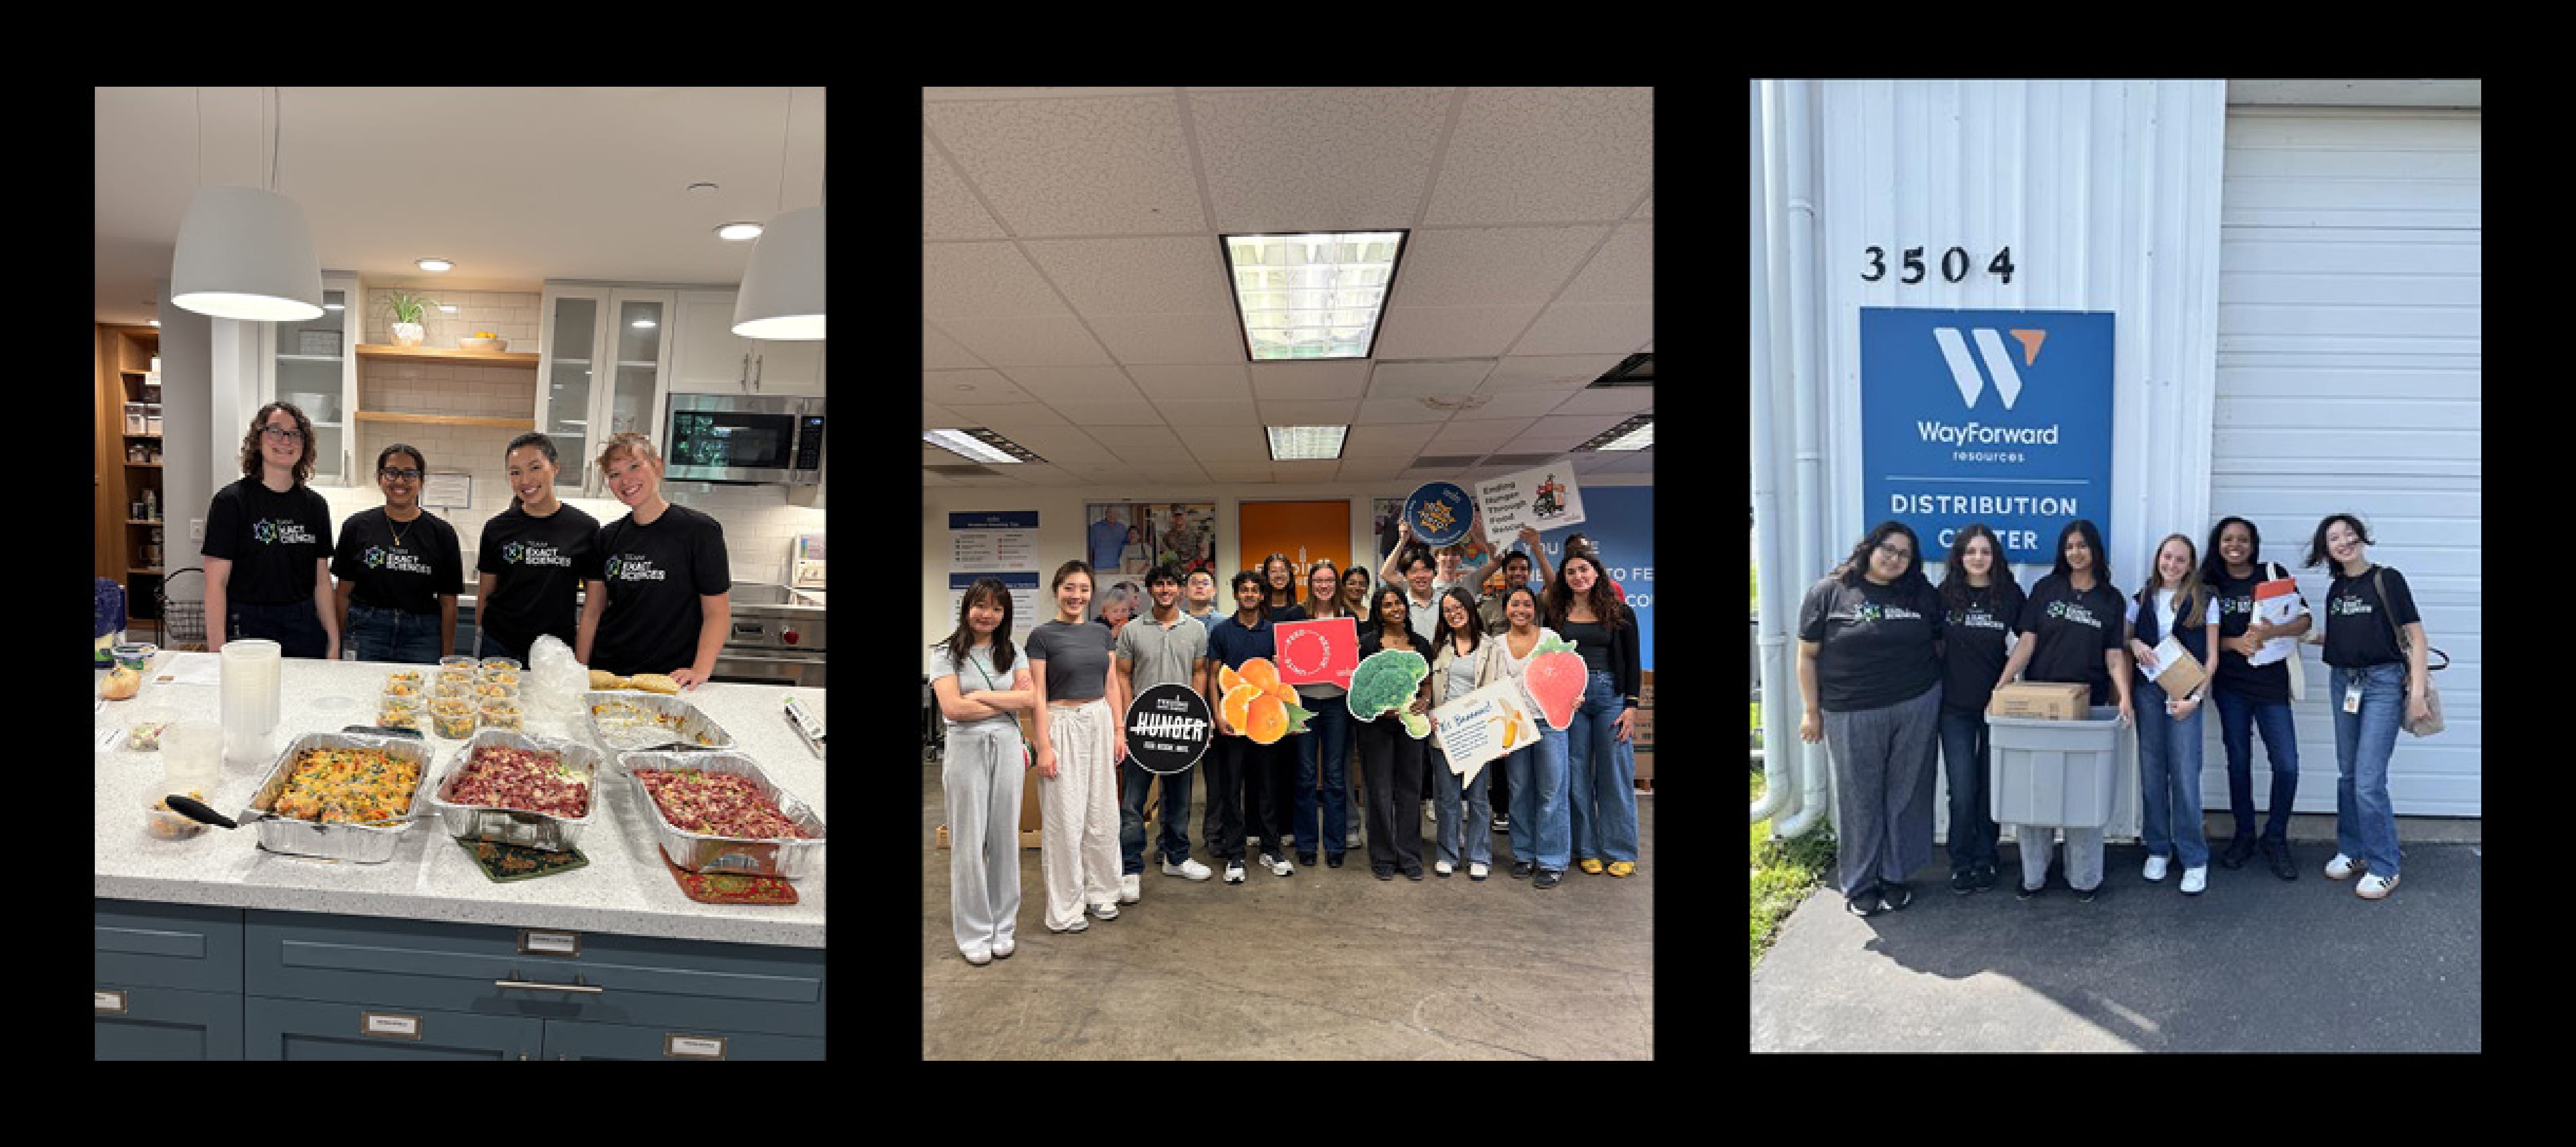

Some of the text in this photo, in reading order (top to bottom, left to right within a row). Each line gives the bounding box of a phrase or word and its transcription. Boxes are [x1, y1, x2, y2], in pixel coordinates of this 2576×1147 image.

[1861, 245, 2015, 285] 3504
[1918, 420, 2059, 446] WayForward
[1953, 452, 2025, 463] resources
[1483, 481, 1516, 495] Ending
[1485, 491, 1519, 504] Hunger
[1488, 500, 1526, 514] Through
[1891, 494, 2076, 516] DISTRIBUTION
[1490, 513, 1514, 524] Food
[1938, 528, 2038, 549] CTER
[525, 547, 558, 557] EXACT
[1136, 711, 1203, 742] HUNGER
